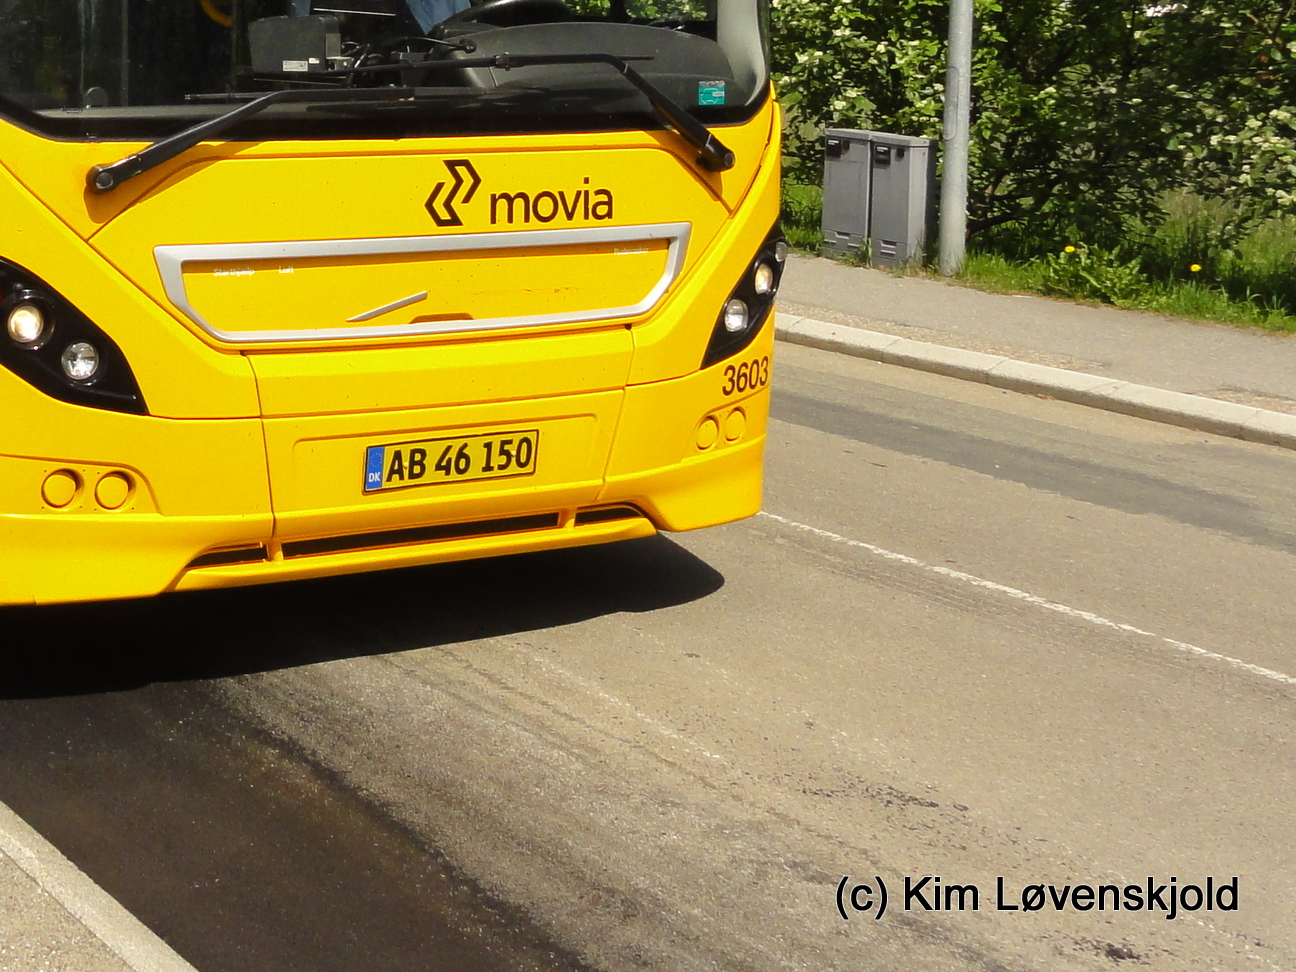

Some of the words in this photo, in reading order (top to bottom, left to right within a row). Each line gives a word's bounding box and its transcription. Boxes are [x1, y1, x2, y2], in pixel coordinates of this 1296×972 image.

[489, 176, 614, 225] movia
[721, 355, 770, 397] 3603
[368, 471, 382, 483] DK
[385, 447, 428, 483] AB
[434, 442, 472, 477] 46
[480, 436, 534, 473] 150
